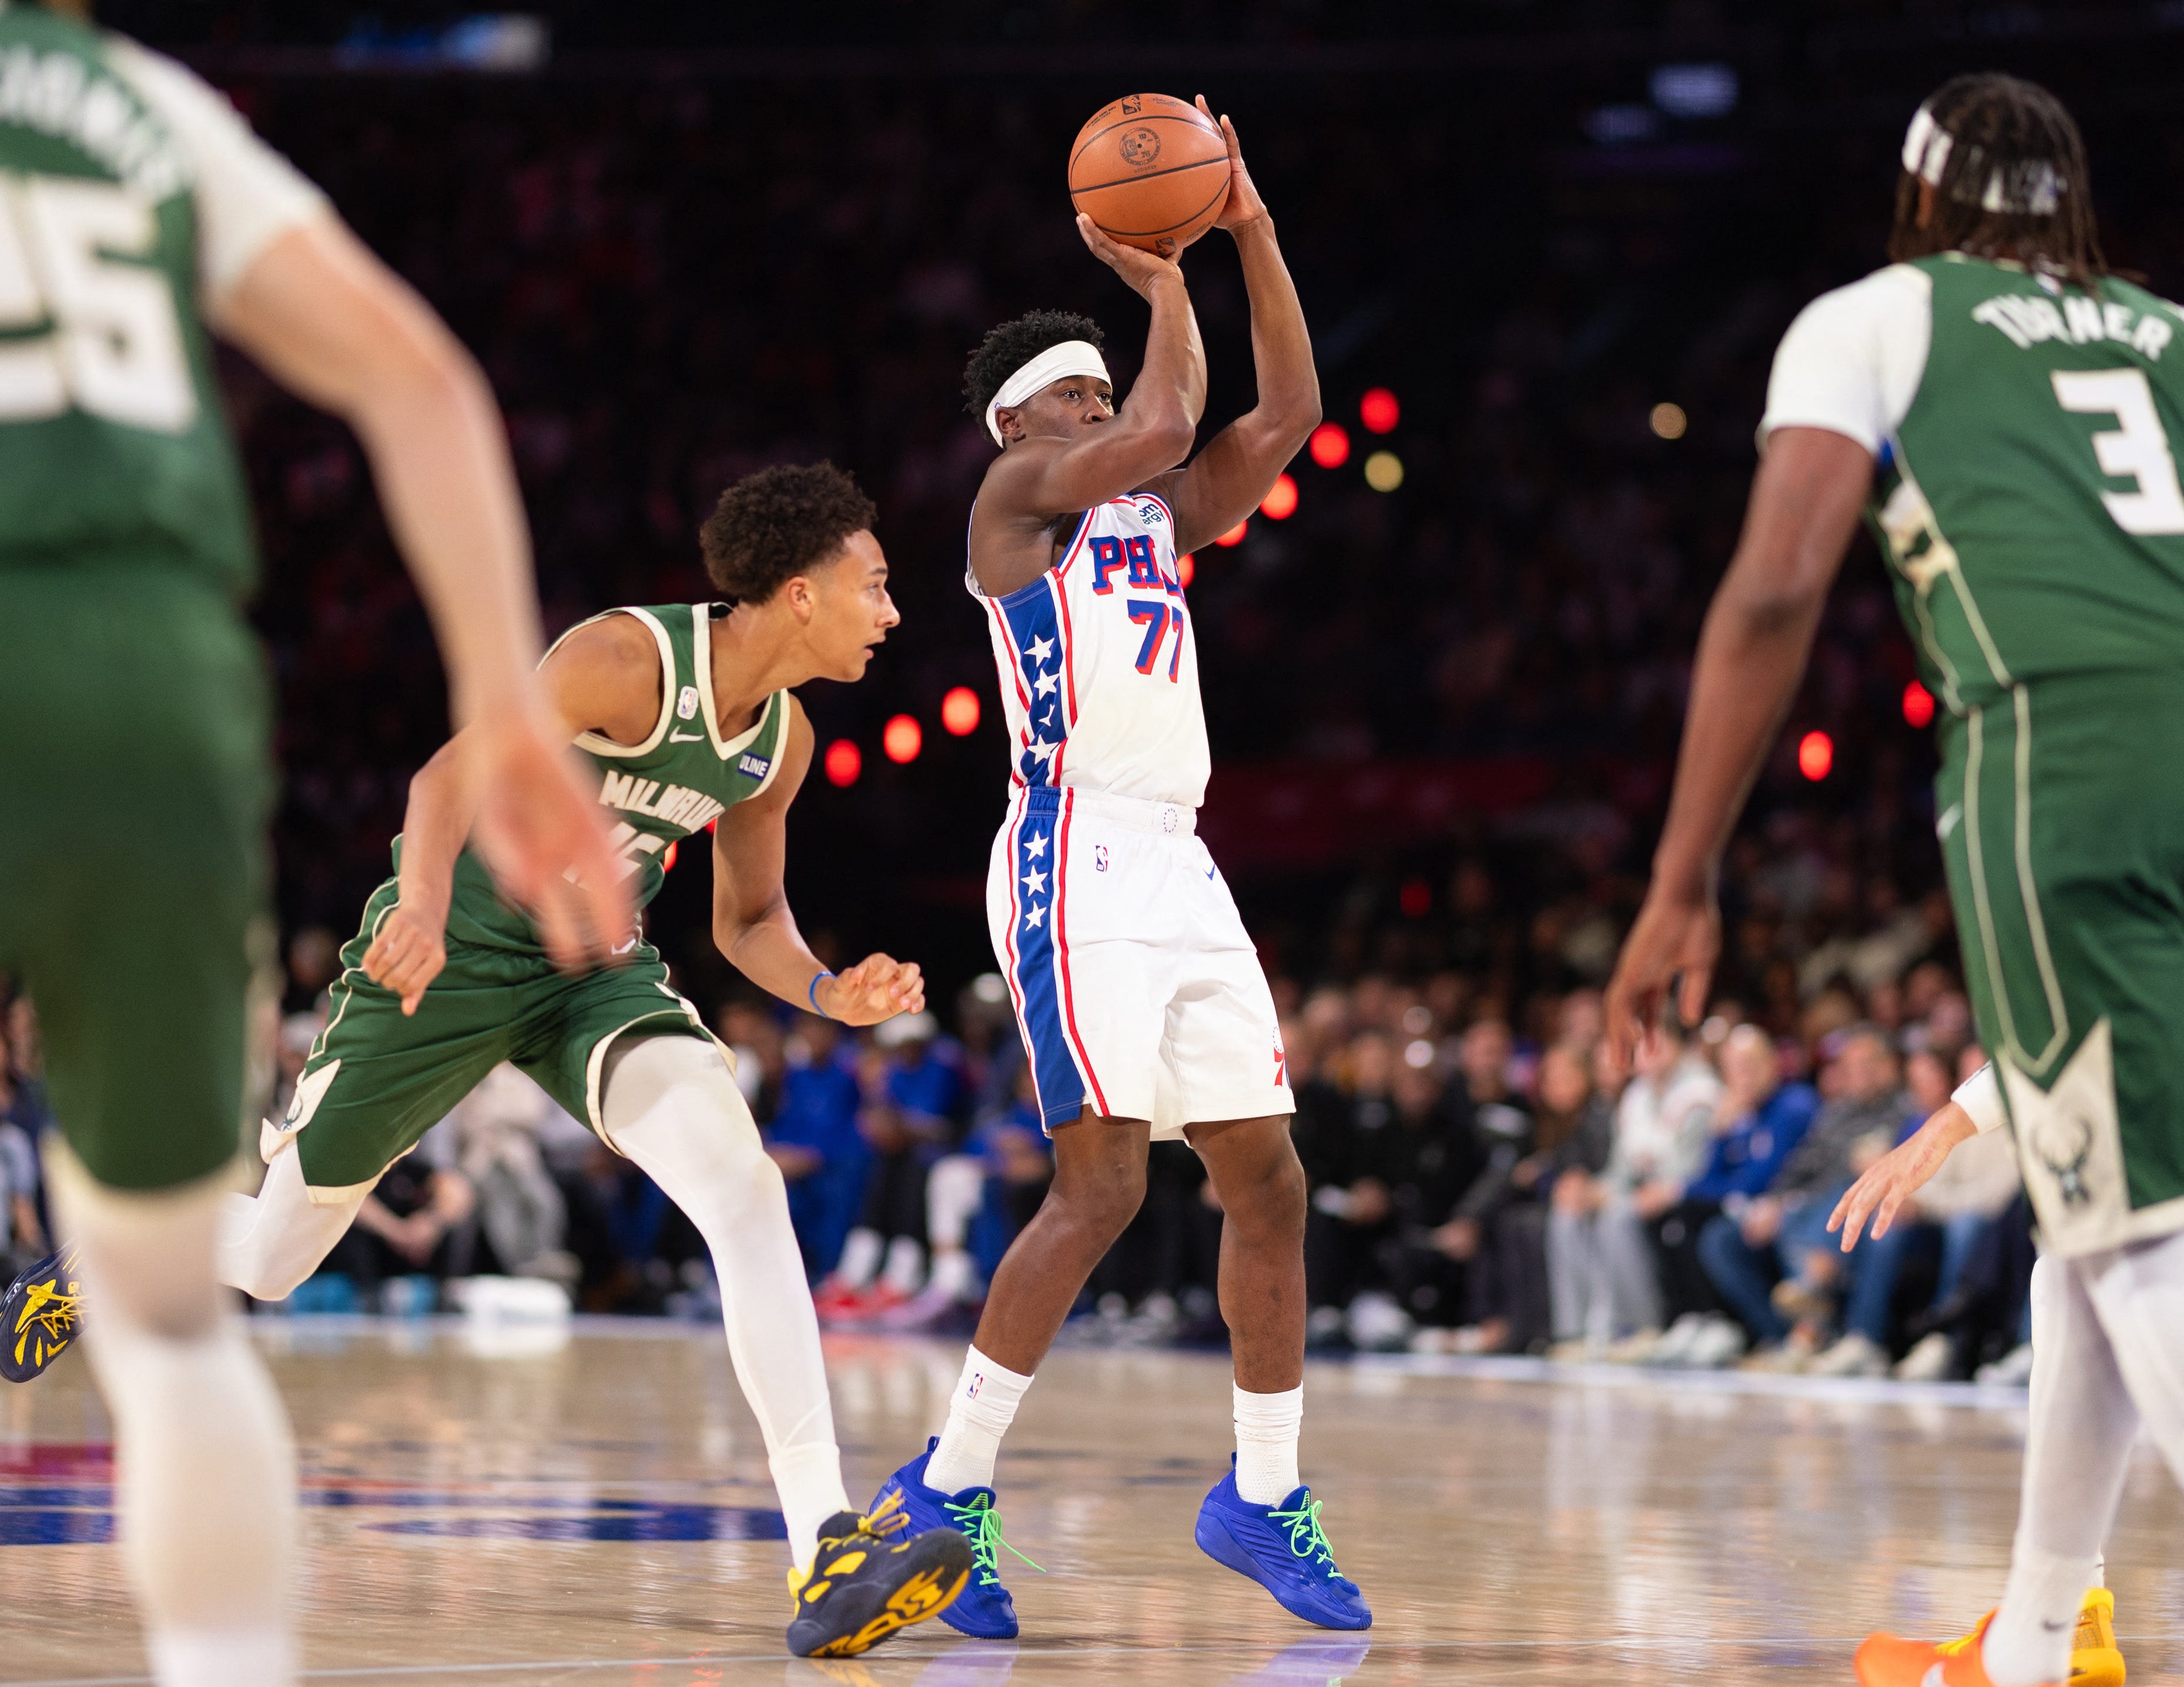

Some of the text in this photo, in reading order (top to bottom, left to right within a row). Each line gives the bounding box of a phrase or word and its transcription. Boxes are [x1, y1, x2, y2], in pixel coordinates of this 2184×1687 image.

[1971, 293, 2173, 361] TURNER
[2050, 367, 2184, 536] 3
[1127, 599, 1184, 684] 77
[739, 755, 769, 777] ULINE
